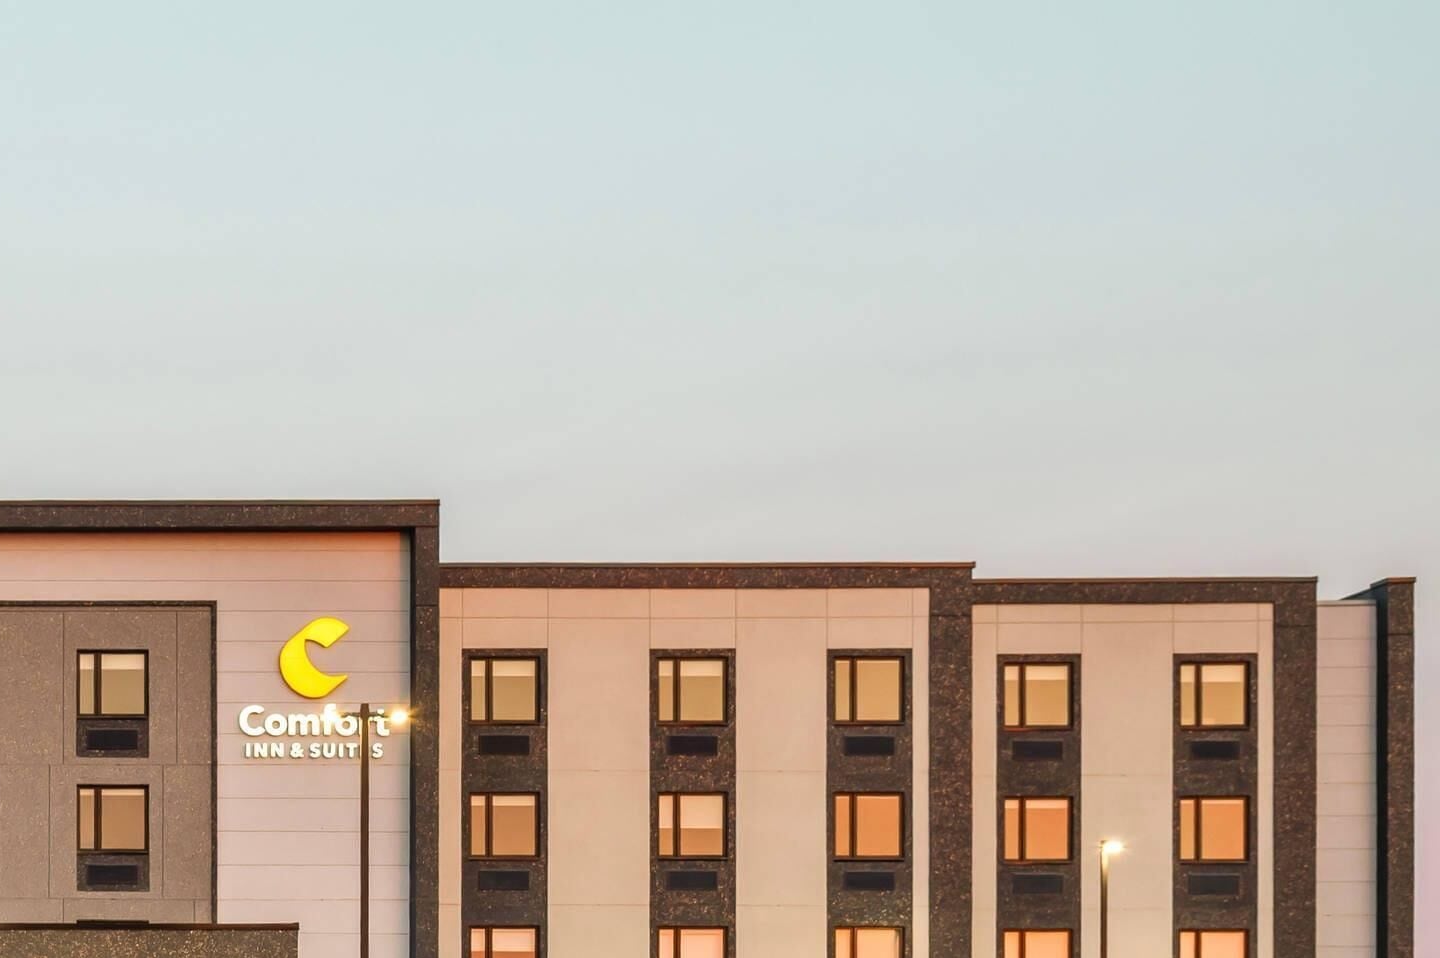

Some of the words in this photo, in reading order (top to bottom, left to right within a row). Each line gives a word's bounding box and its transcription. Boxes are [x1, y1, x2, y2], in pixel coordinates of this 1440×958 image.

[245, 742, 285, 758] INN
[290, 742, 305, 758] &
[309, 742, 384, 758] SUITS
